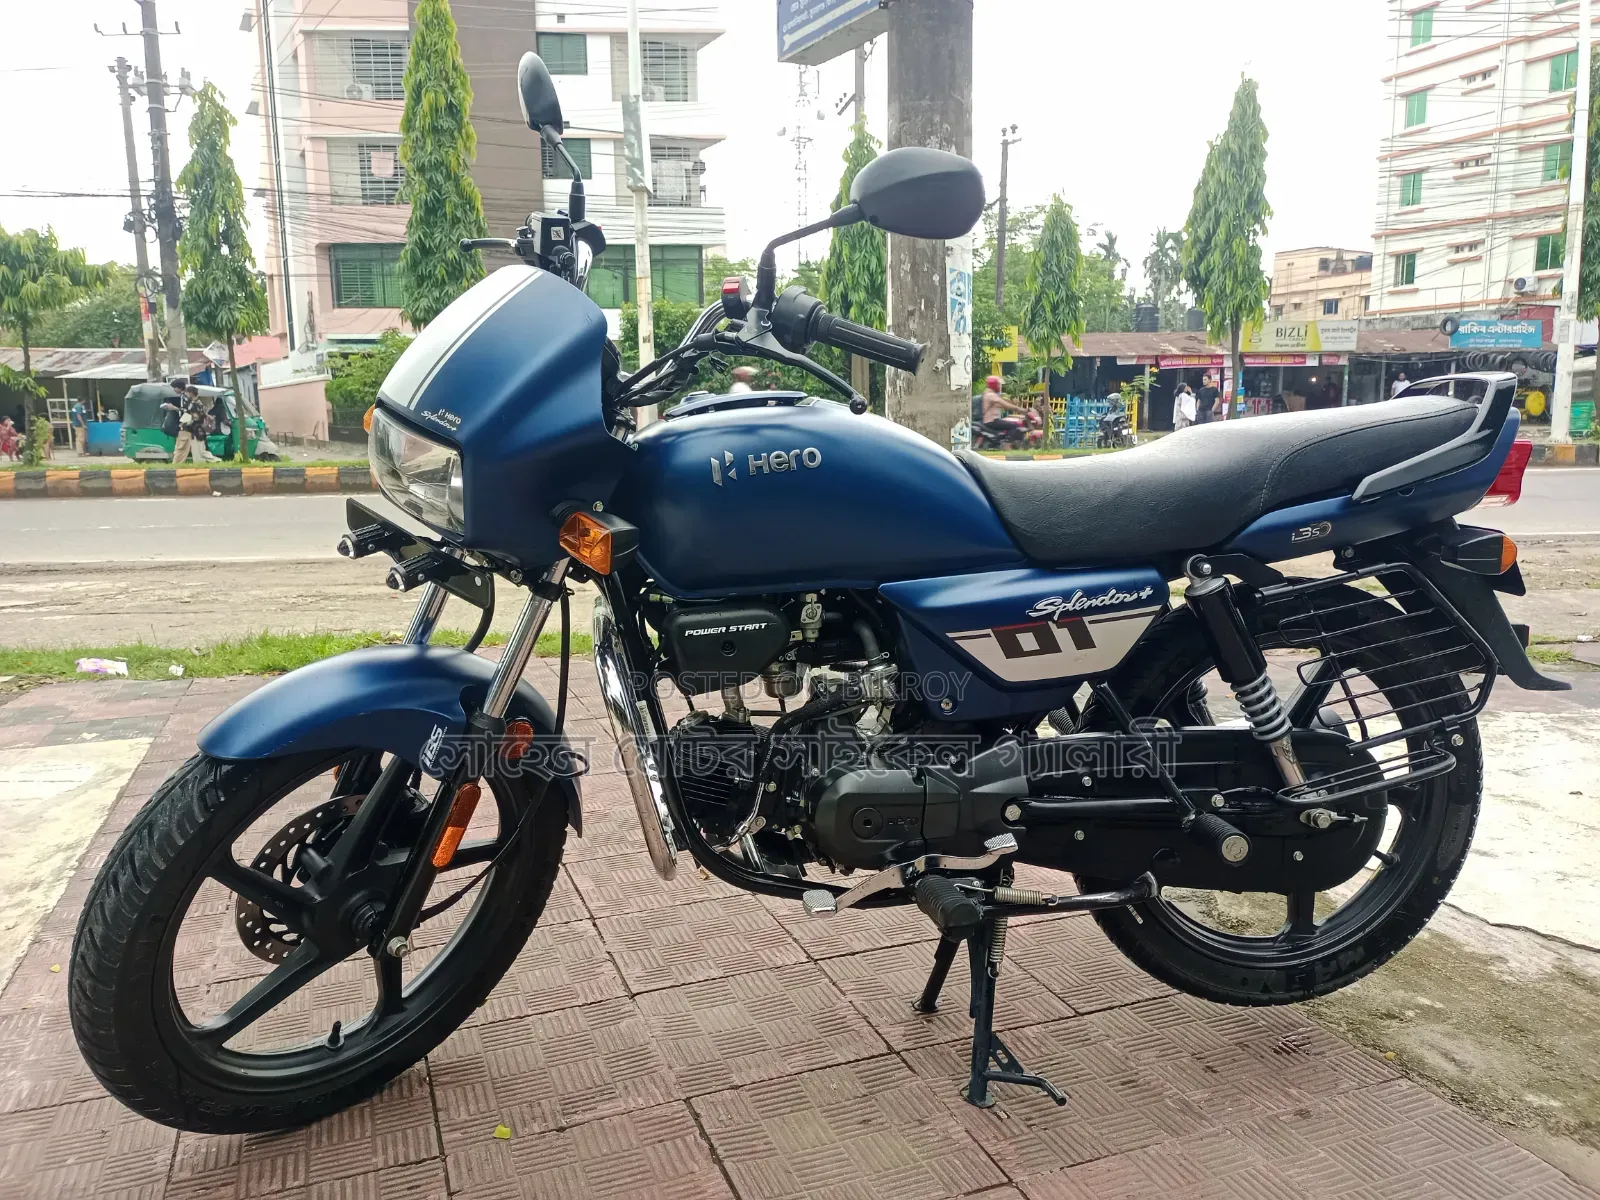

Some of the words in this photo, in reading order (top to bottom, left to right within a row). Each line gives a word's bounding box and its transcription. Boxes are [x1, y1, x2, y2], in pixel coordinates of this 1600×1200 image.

[1458, 322, 1485, 334] রাকিব
[445, 412, 461, 424] Hero
[747, 447, 822, 476] Hero
[684, 626, 727, 637] POWER
[728, 622, 768, 633] START
[991, 616, 1097, 659] 01
